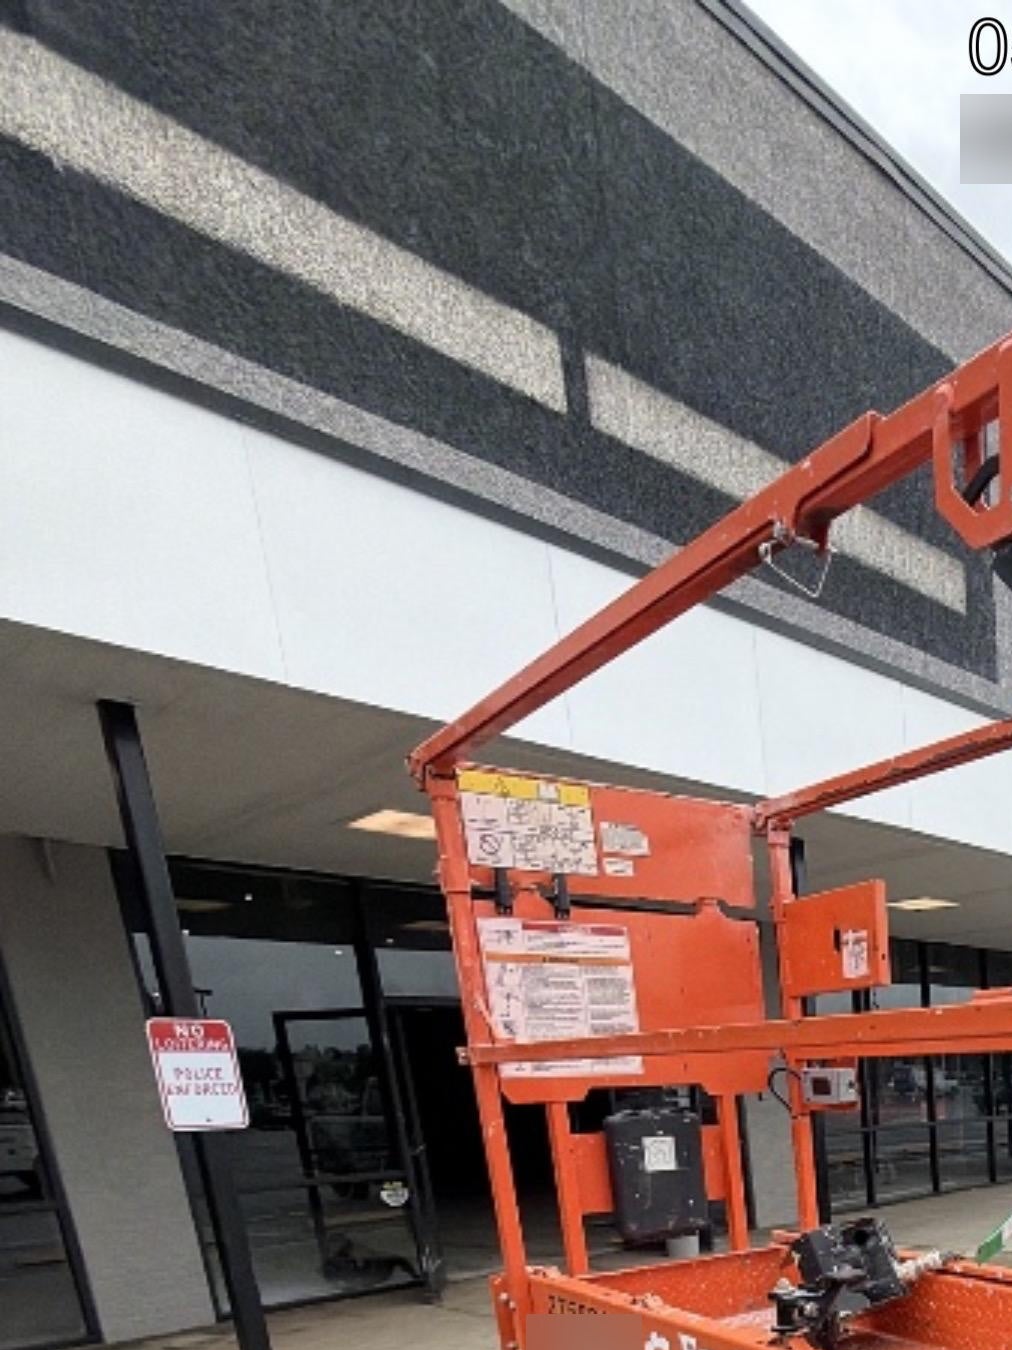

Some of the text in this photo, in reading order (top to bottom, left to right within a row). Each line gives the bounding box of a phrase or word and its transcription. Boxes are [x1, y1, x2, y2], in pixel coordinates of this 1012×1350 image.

[174, 1024, 204, 1038] NO
[174, 1067, 223, 1081] POLICE
[167, 1083, 238, 1096] ENFORCED
